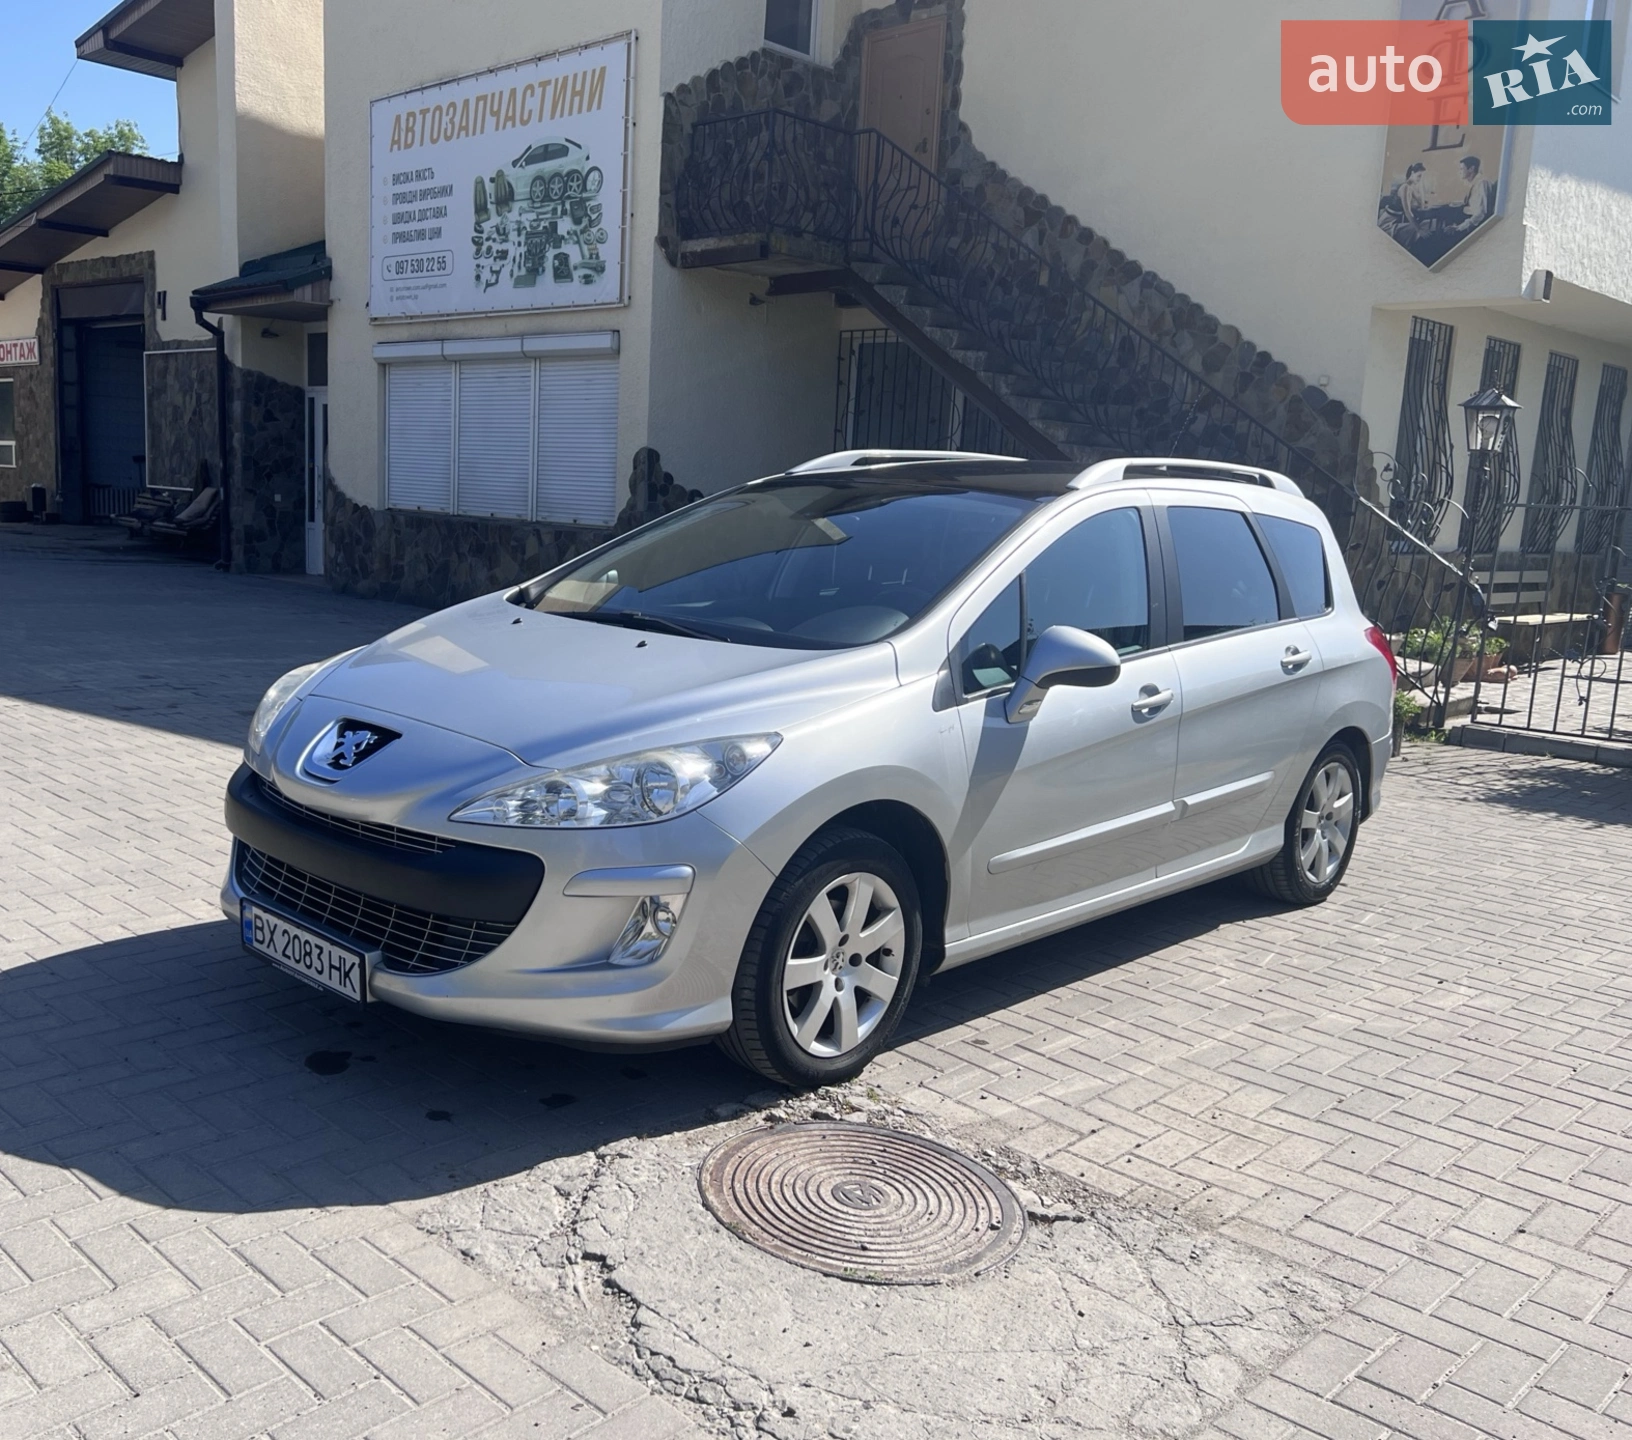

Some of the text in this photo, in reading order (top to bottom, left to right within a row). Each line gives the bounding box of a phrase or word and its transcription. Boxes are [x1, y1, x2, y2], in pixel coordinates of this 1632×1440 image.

[389, 65, 607, 153] АВТОЗАПЧАСТИНИ
[392, 167, 435, 186] ВИСОКА ЯКІСТЬ
[392, 183, 453, 205] ПРОВІДНІ ВИРОБНИКИ
[392, 205, 447, 225] ШВИДКА ДОСТАВКА
[392, 226, 442, 244] ПРИВАБЛИВІ ЦІНИ
[395, 255, 447, 275] 097 530 22 55
[0, 341, 37, 362] ОНТАЖ
[281, 929, 324, 975] 2083
